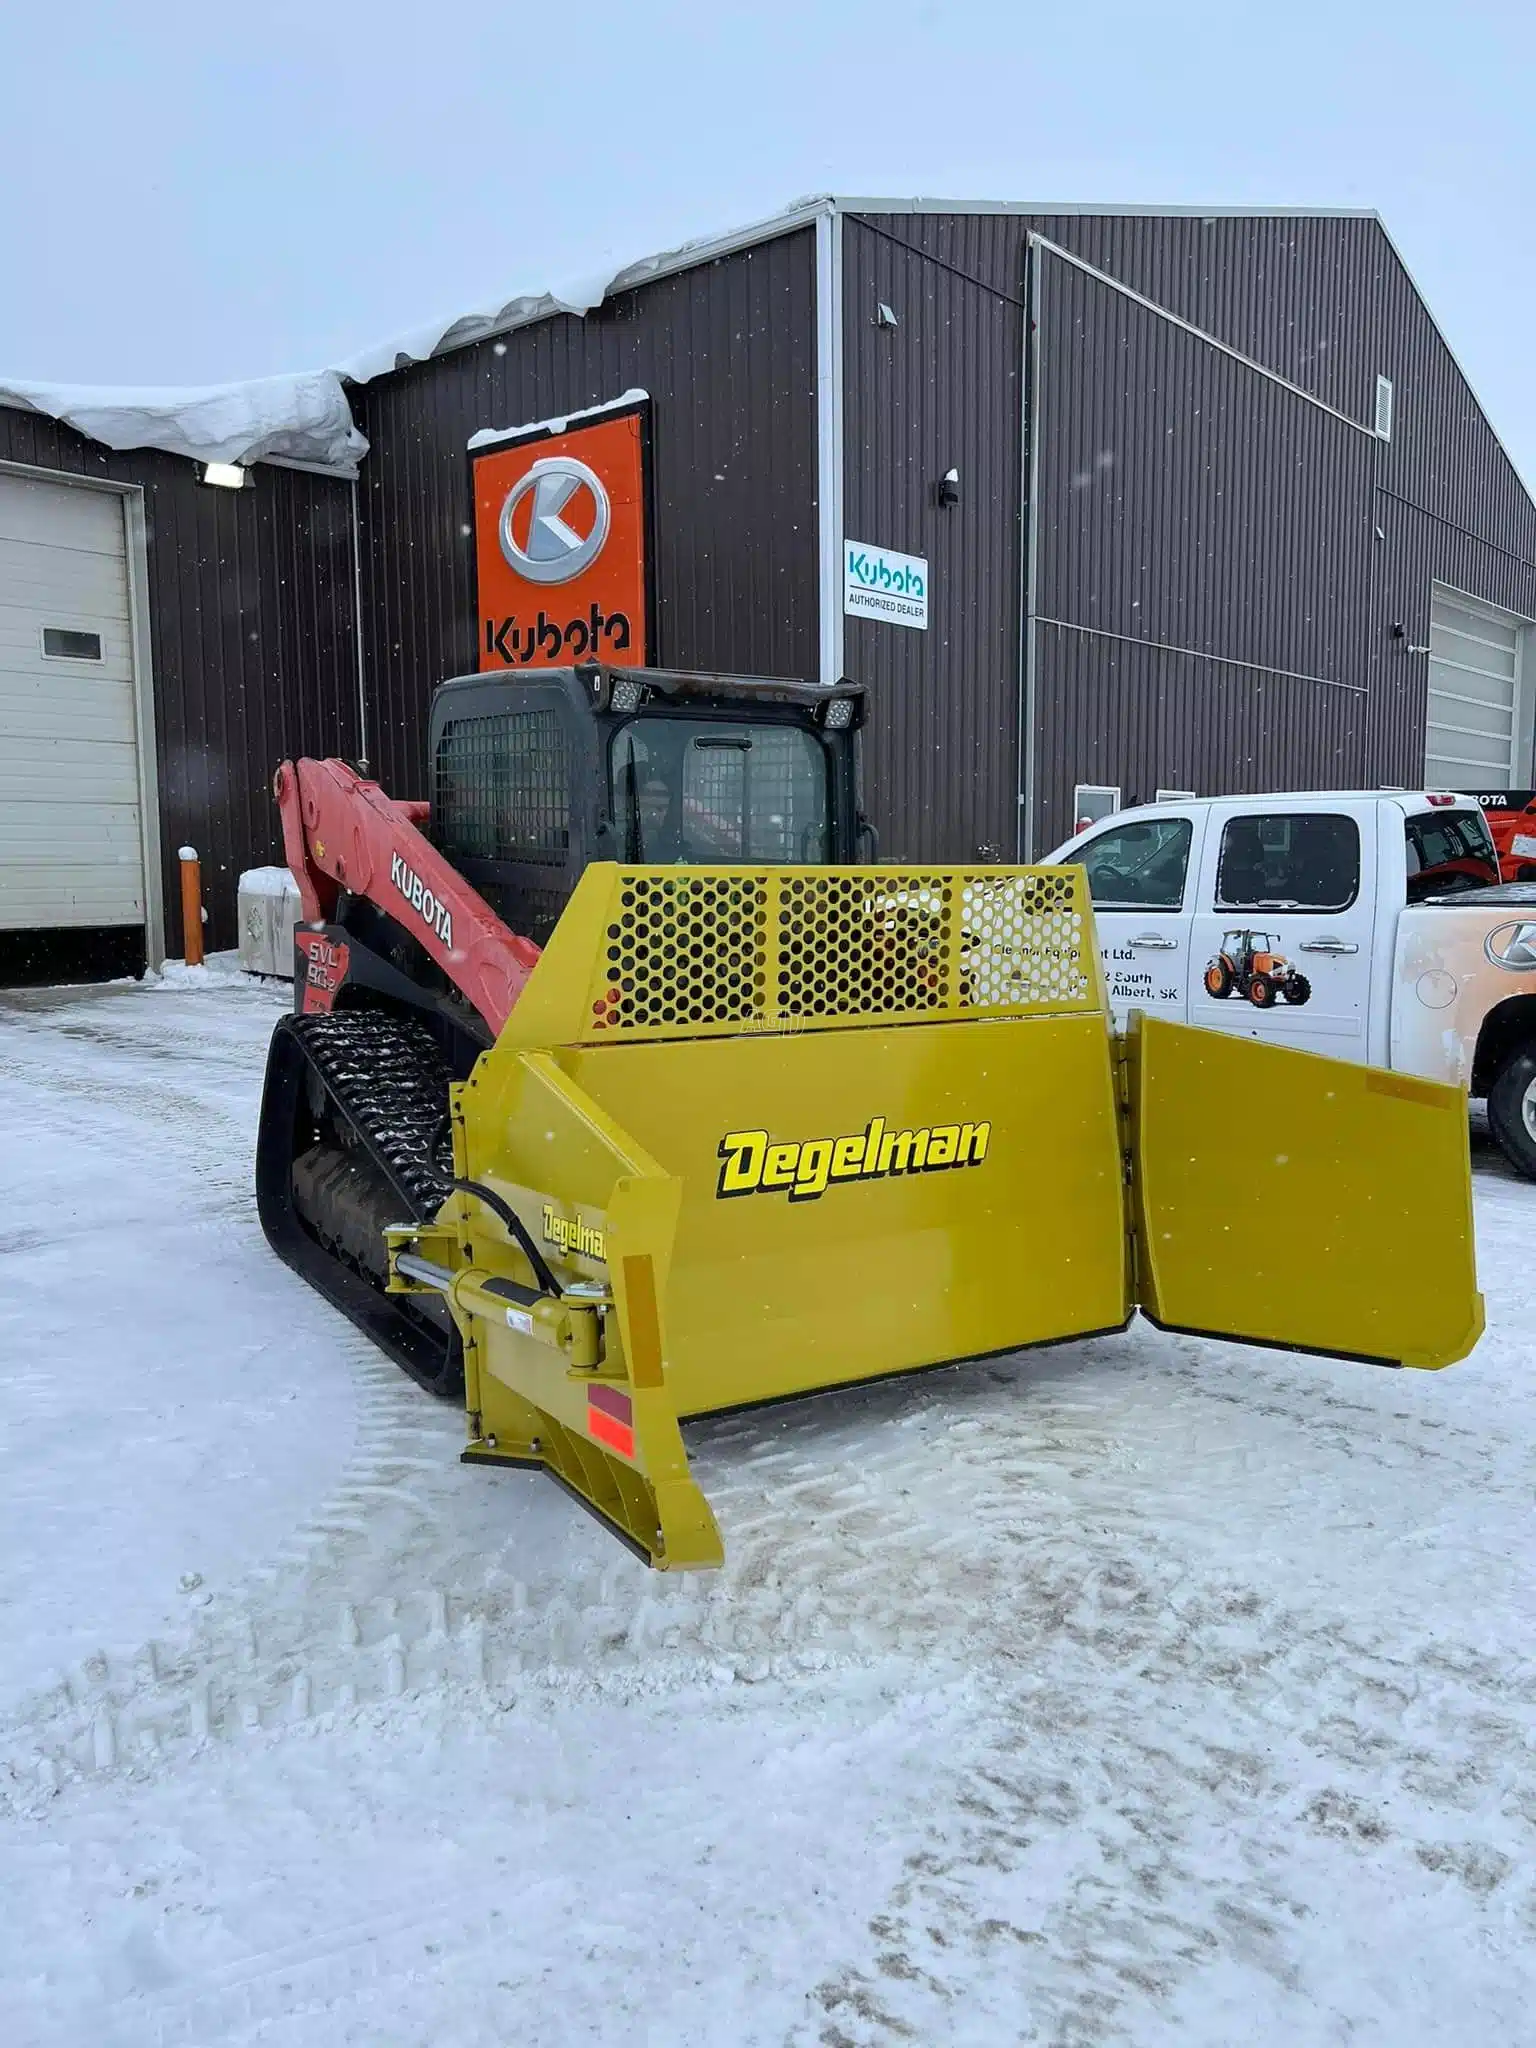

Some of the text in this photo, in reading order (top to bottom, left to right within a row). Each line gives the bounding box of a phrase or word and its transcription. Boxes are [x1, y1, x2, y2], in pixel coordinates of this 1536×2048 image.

[849, 551, 924, 597] Kubota
[849, 593, 924, 617] AUTHORIZED DEALER
[485, 602, 632, 665] Kubota
[390, 849, 453, 951] KUBOTA
[308, 942, 338, 970] SVL
[1113, 948, 1136, 961] Ltd.
[1111, 985, 1178, 1000] Albert, SK
[1114, 971, 1152, 984] South
[716, 1116, 992, 1203] Degelman
[542, 1203, 608, 1264] Degelma
